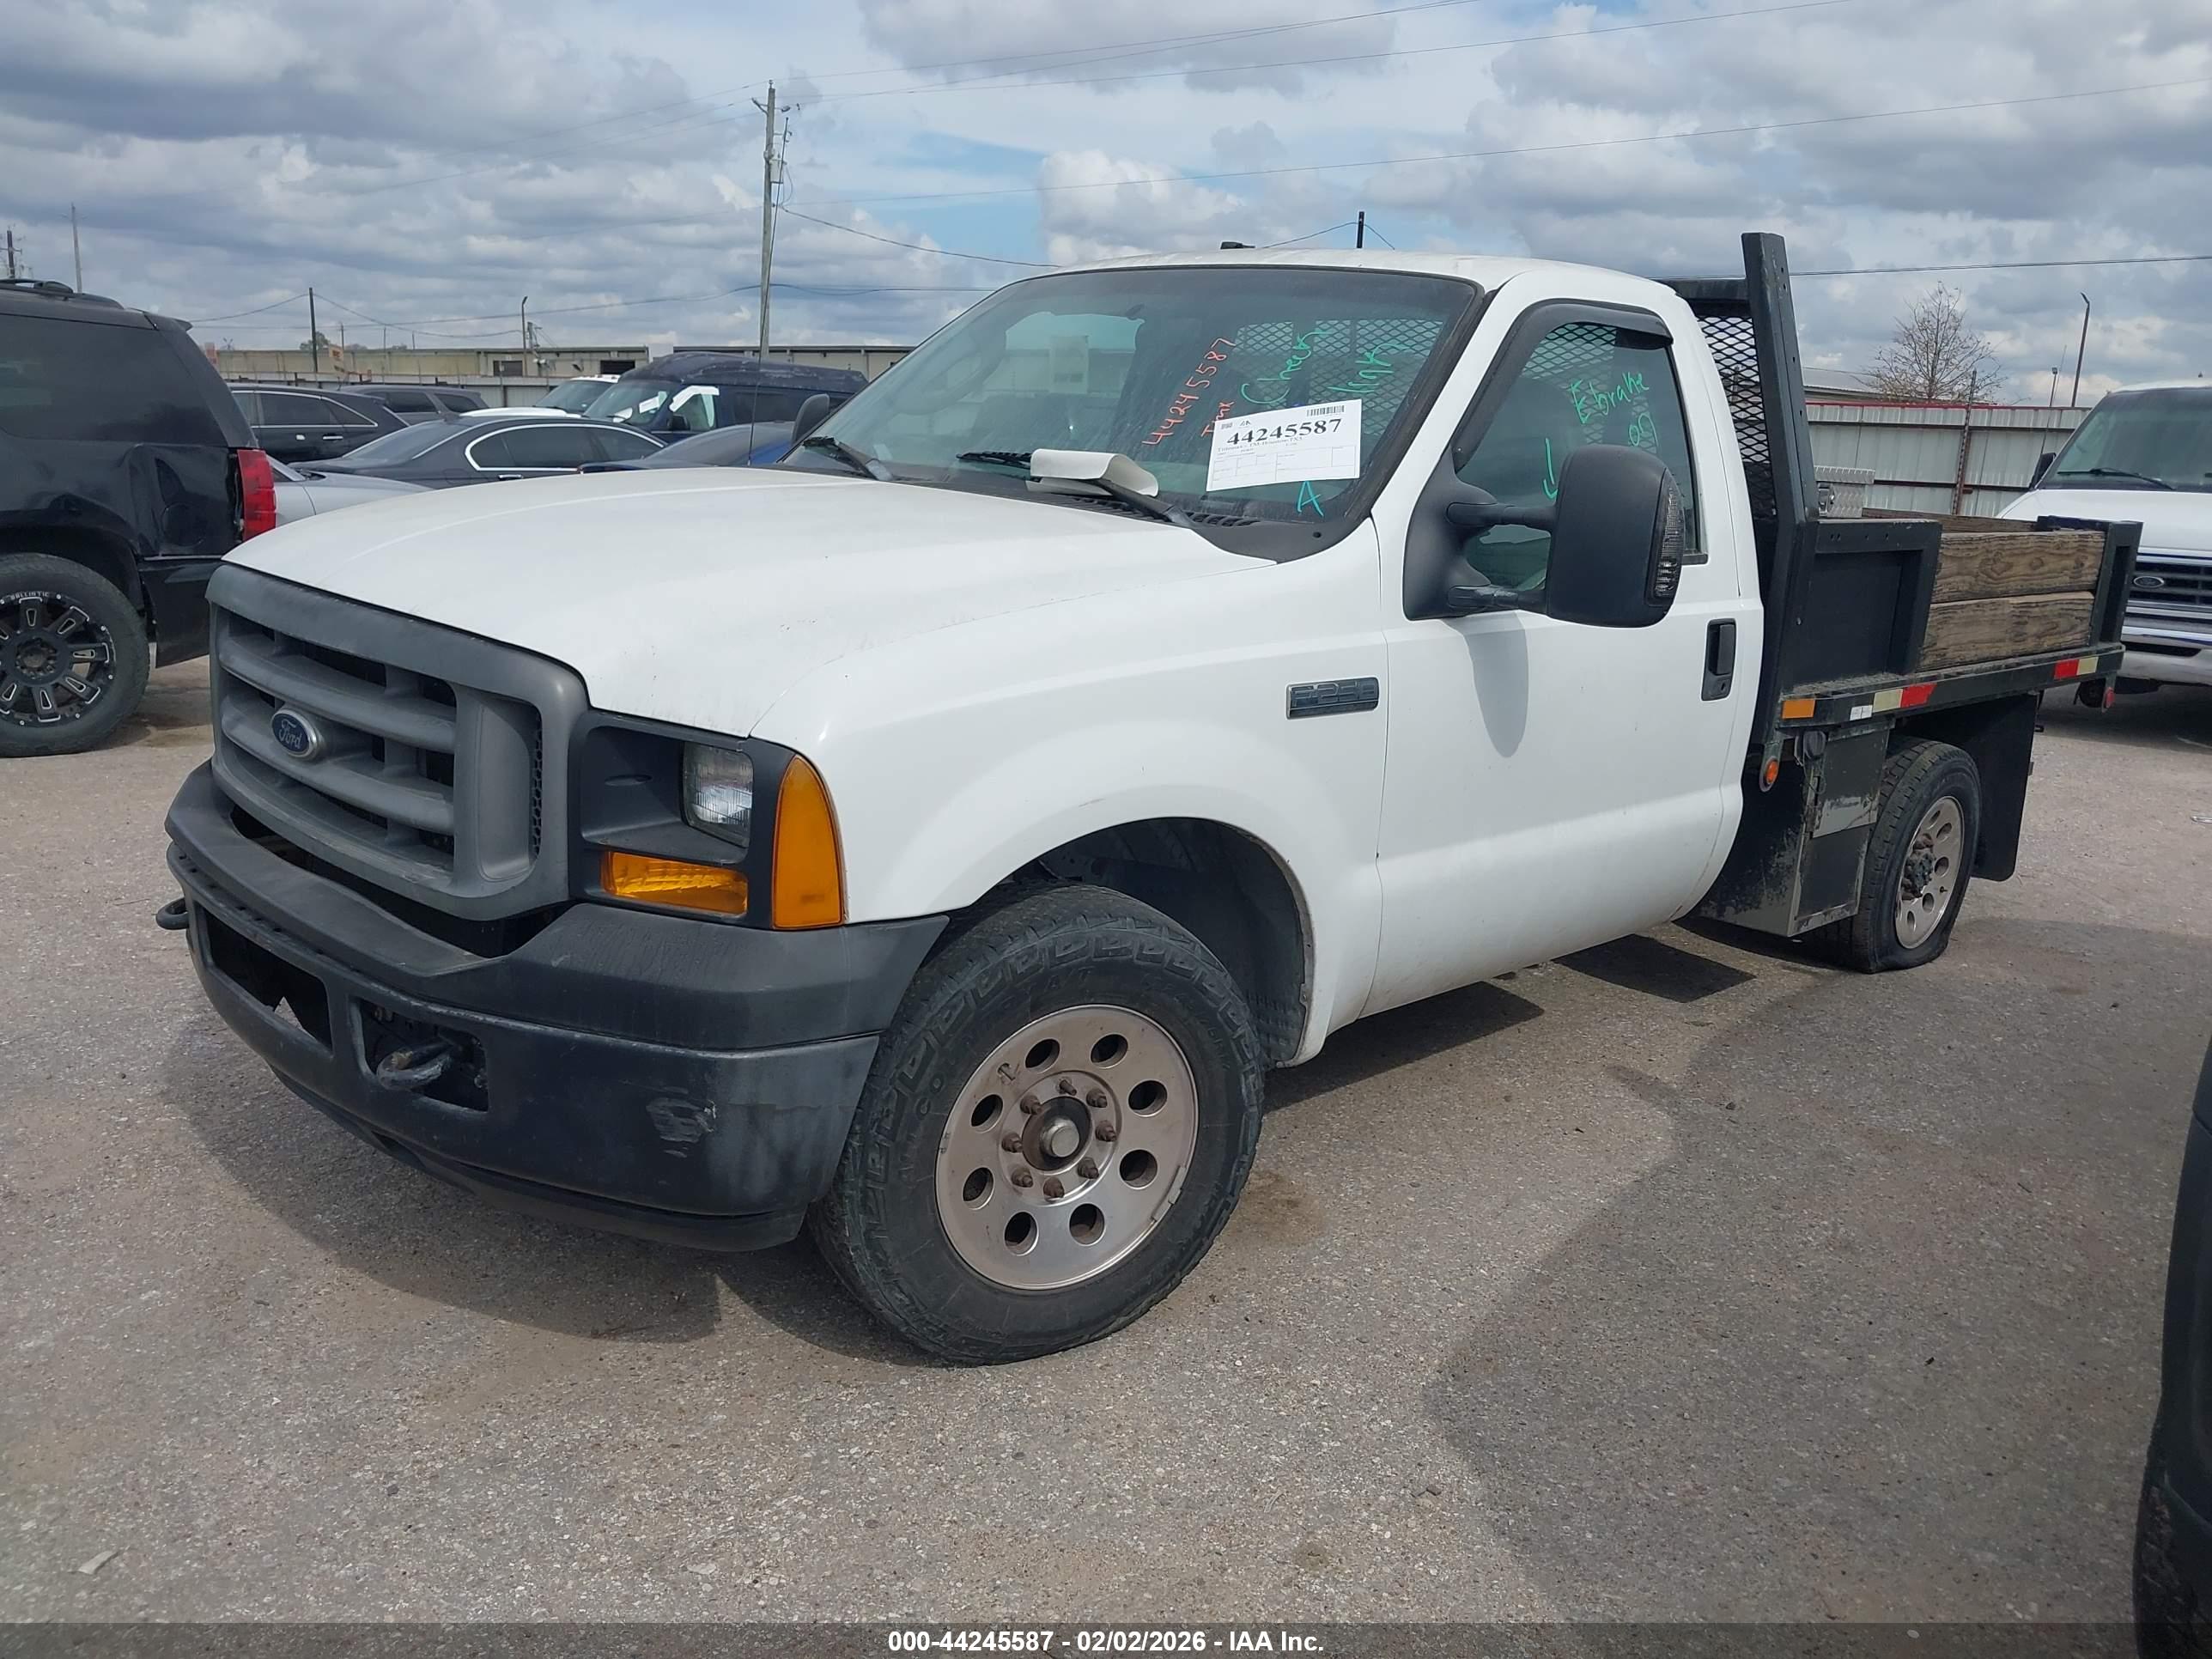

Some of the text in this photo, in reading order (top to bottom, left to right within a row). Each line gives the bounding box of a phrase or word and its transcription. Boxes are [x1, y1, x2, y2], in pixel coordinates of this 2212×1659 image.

[1241, 331, 1333, 404] Check
[1141, 337, 1237, 446] 44245587
[1226, 418, 1342, 446] 44245587
[1297, 481, 1324, 518] A
[279, 719, 303, 750] Ford
